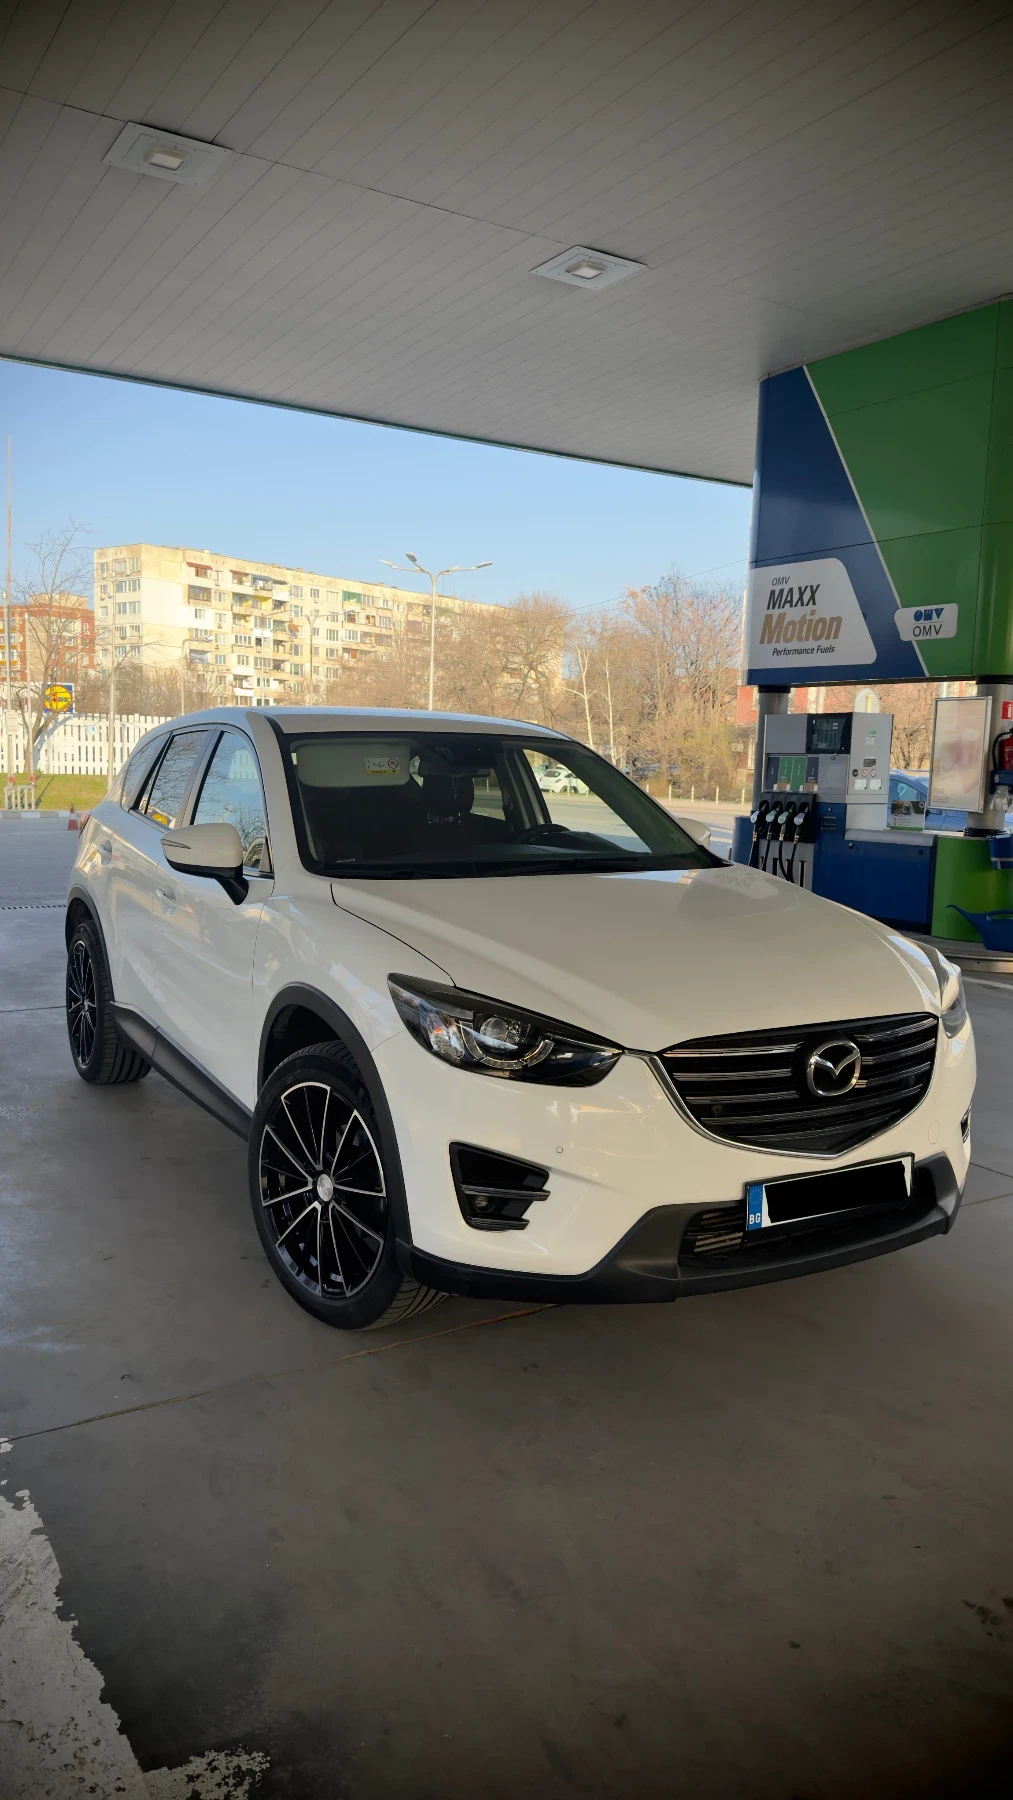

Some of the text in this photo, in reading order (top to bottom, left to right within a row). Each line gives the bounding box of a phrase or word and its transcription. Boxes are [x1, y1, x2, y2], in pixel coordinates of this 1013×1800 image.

[771, 576, 790, 586] OMV
[766, 584, 820, 610] MAXX
[759, 609, 843, 644] Motion
[912, 624, 943, 637] OMV
[772, 645, 836, 656] Performance Fuels
[749, 1213, 761, 1224] BG
